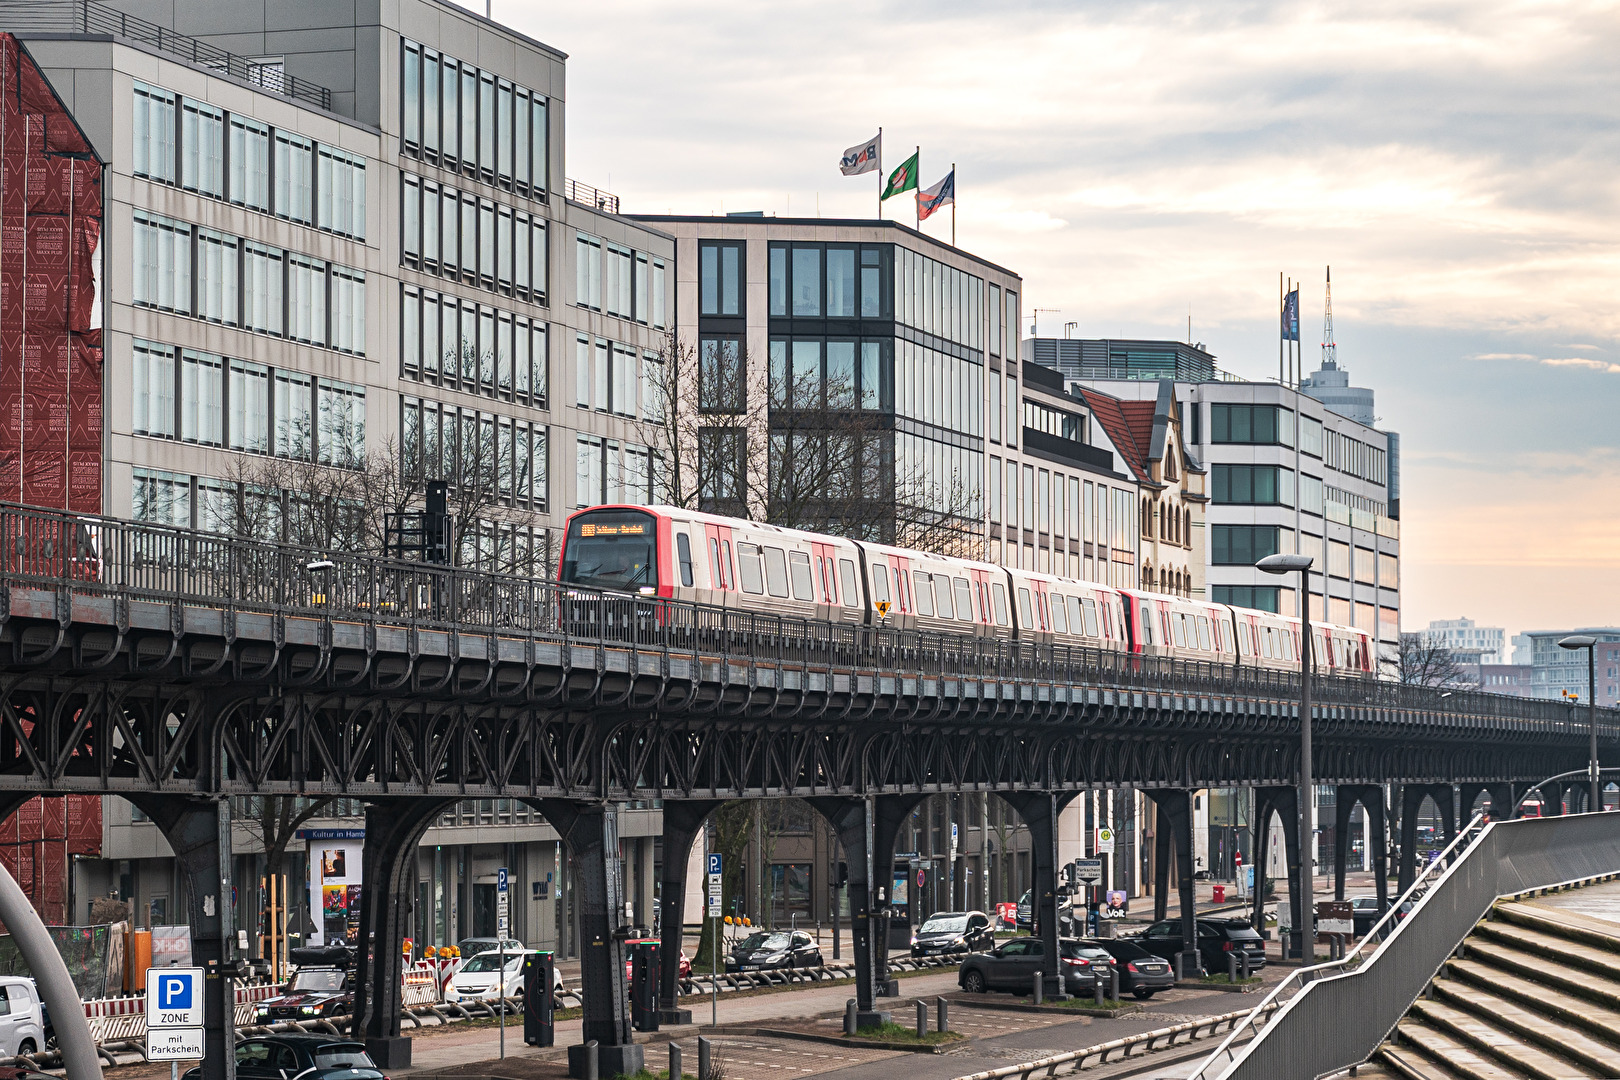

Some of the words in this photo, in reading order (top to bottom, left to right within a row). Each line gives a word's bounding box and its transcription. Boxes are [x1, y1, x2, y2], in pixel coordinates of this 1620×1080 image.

[880, 603, 886, 612] 4
[710, 856, 718, 872] P
[500, 871, 505, 888] P
[1108, 909, 1125, 918] Volt
[167, 979, 184, 1004] P
[161, 1014, 189, 1023] ZONE
